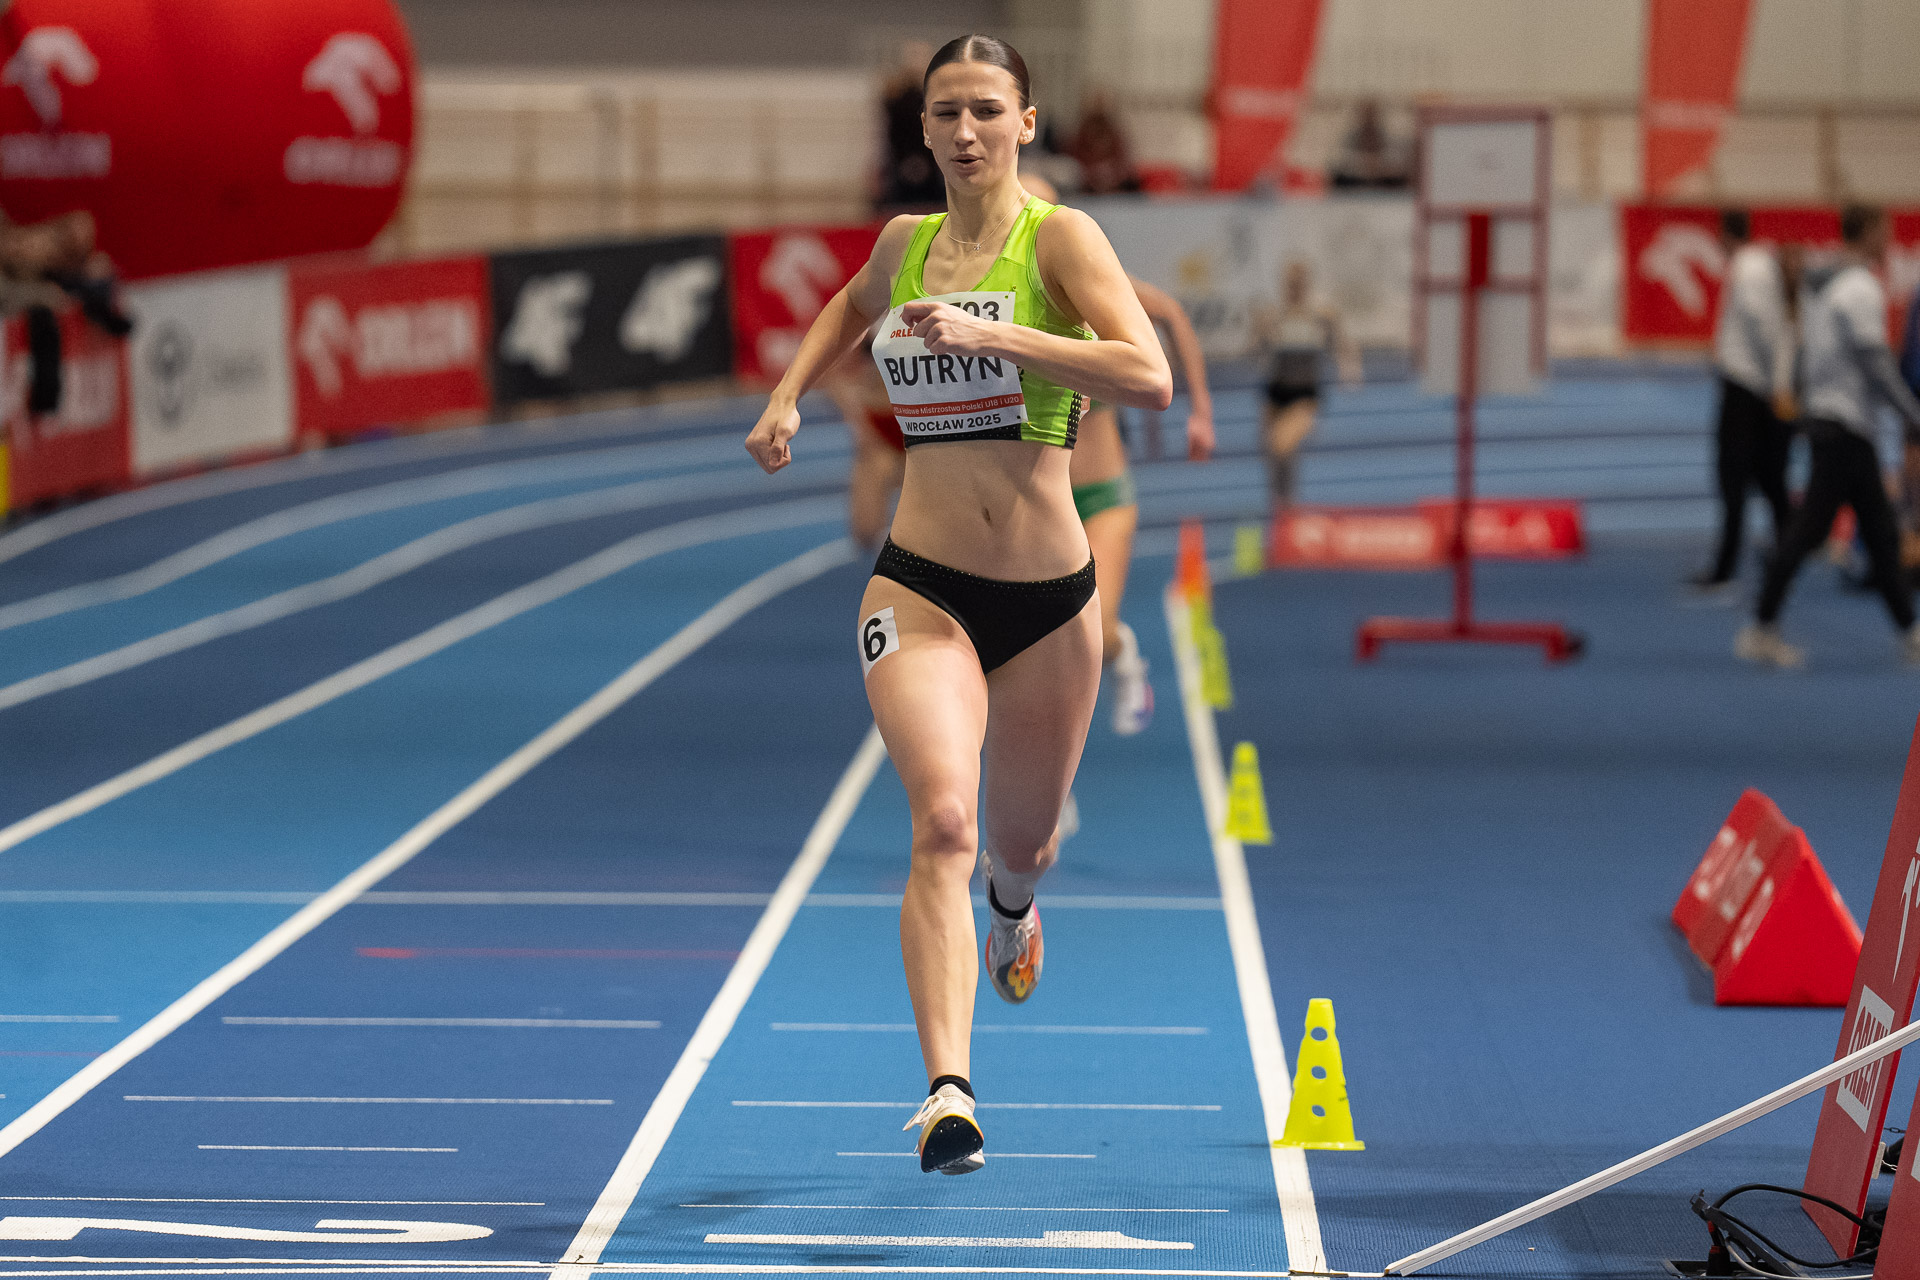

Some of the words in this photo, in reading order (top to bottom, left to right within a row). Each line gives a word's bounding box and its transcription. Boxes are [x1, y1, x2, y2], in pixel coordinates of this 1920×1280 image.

[949, 301, 1000, 322] 03
[884, 354, 1004, 387] BUTRYN
[920, 405, 961, 415] Mistrzostwa
[961, 401, 984, 411] Polski
[985, 399, 999, 408] U18
[1004, 396, 1020, 404] U20
[905, 419, 964, 432] WROCŁAW
[967, 413, 1002, 428] 2025
[863, 617, 887, 662] 6
